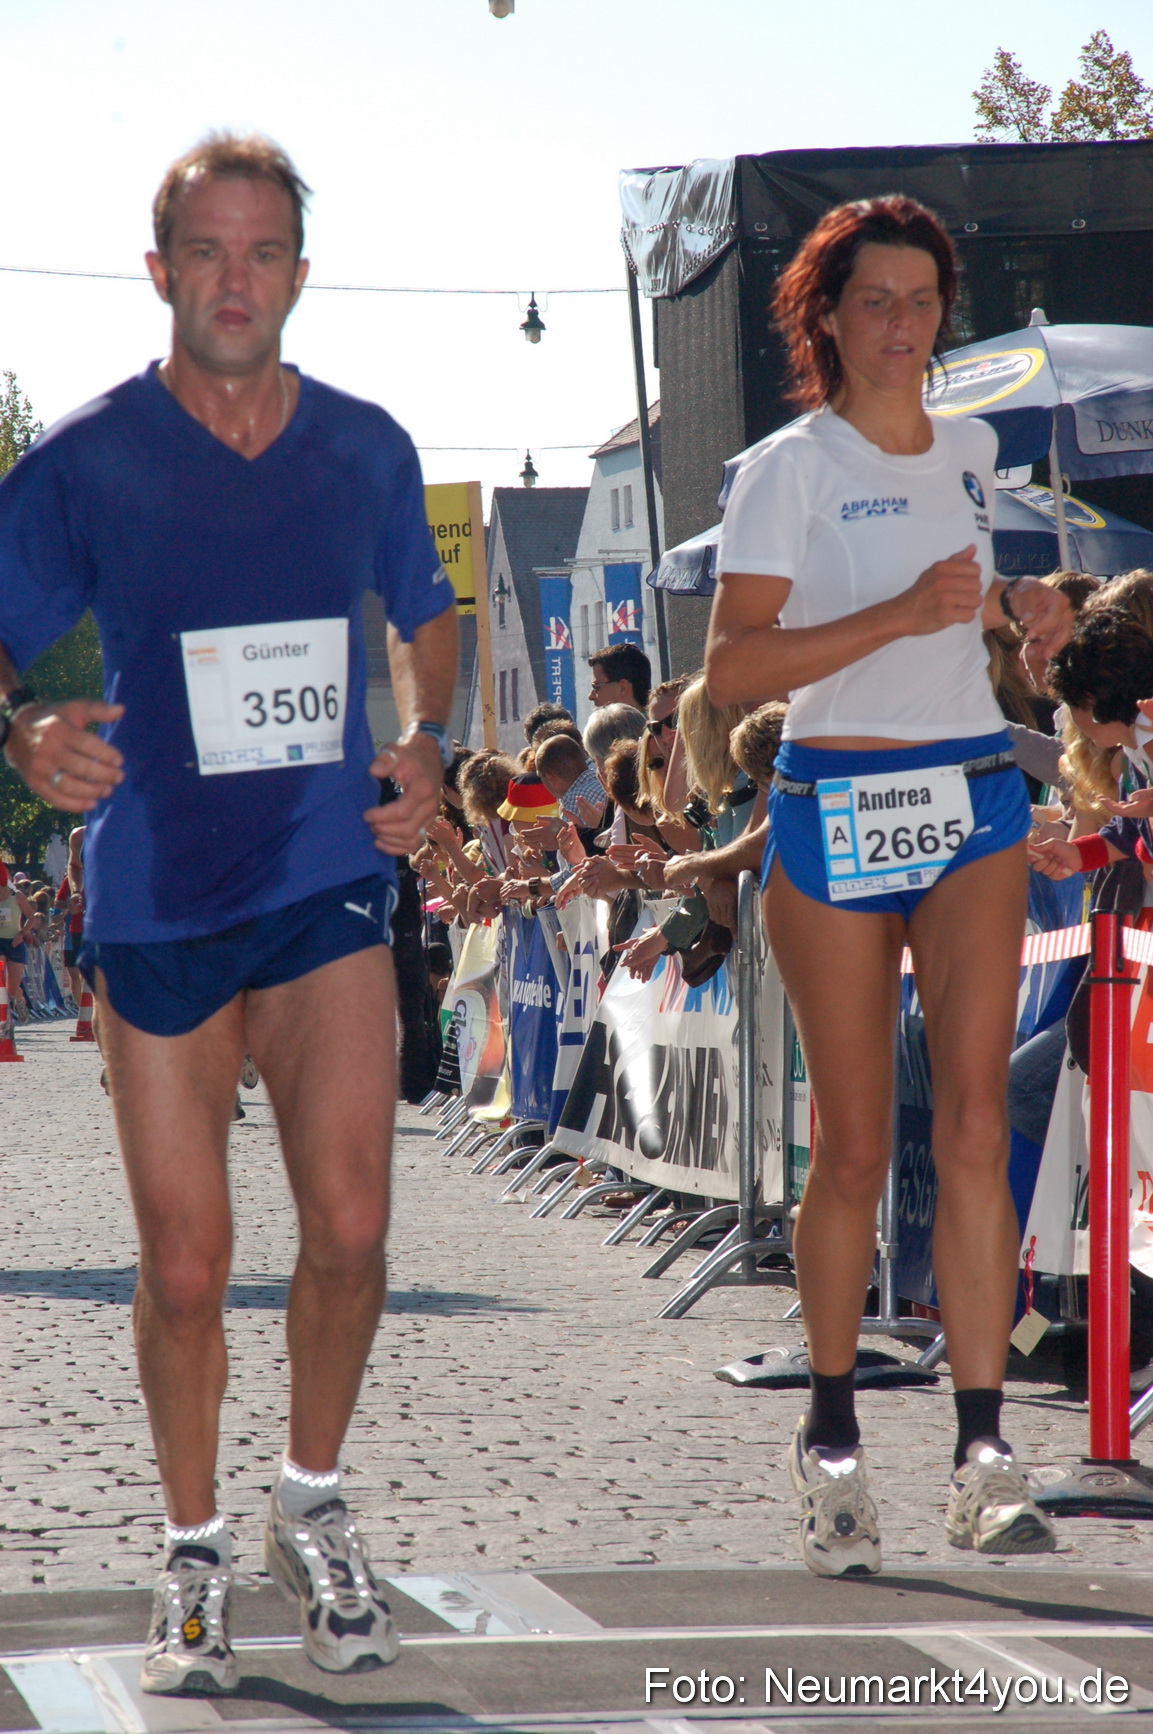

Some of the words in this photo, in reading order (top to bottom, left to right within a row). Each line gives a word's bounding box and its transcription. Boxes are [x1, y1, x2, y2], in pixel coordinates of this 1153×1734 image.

[841, 497, 908, 514] ABRAHAM
[437, 543, 461, 564] uf
[242, 642, 311, 661] Günter
[243, 684, 338, 728] 3506
[858, 787, 932, 812] Andrea
[832, 826, 848, 845] A
[865, 819, 965, 864] 2665
